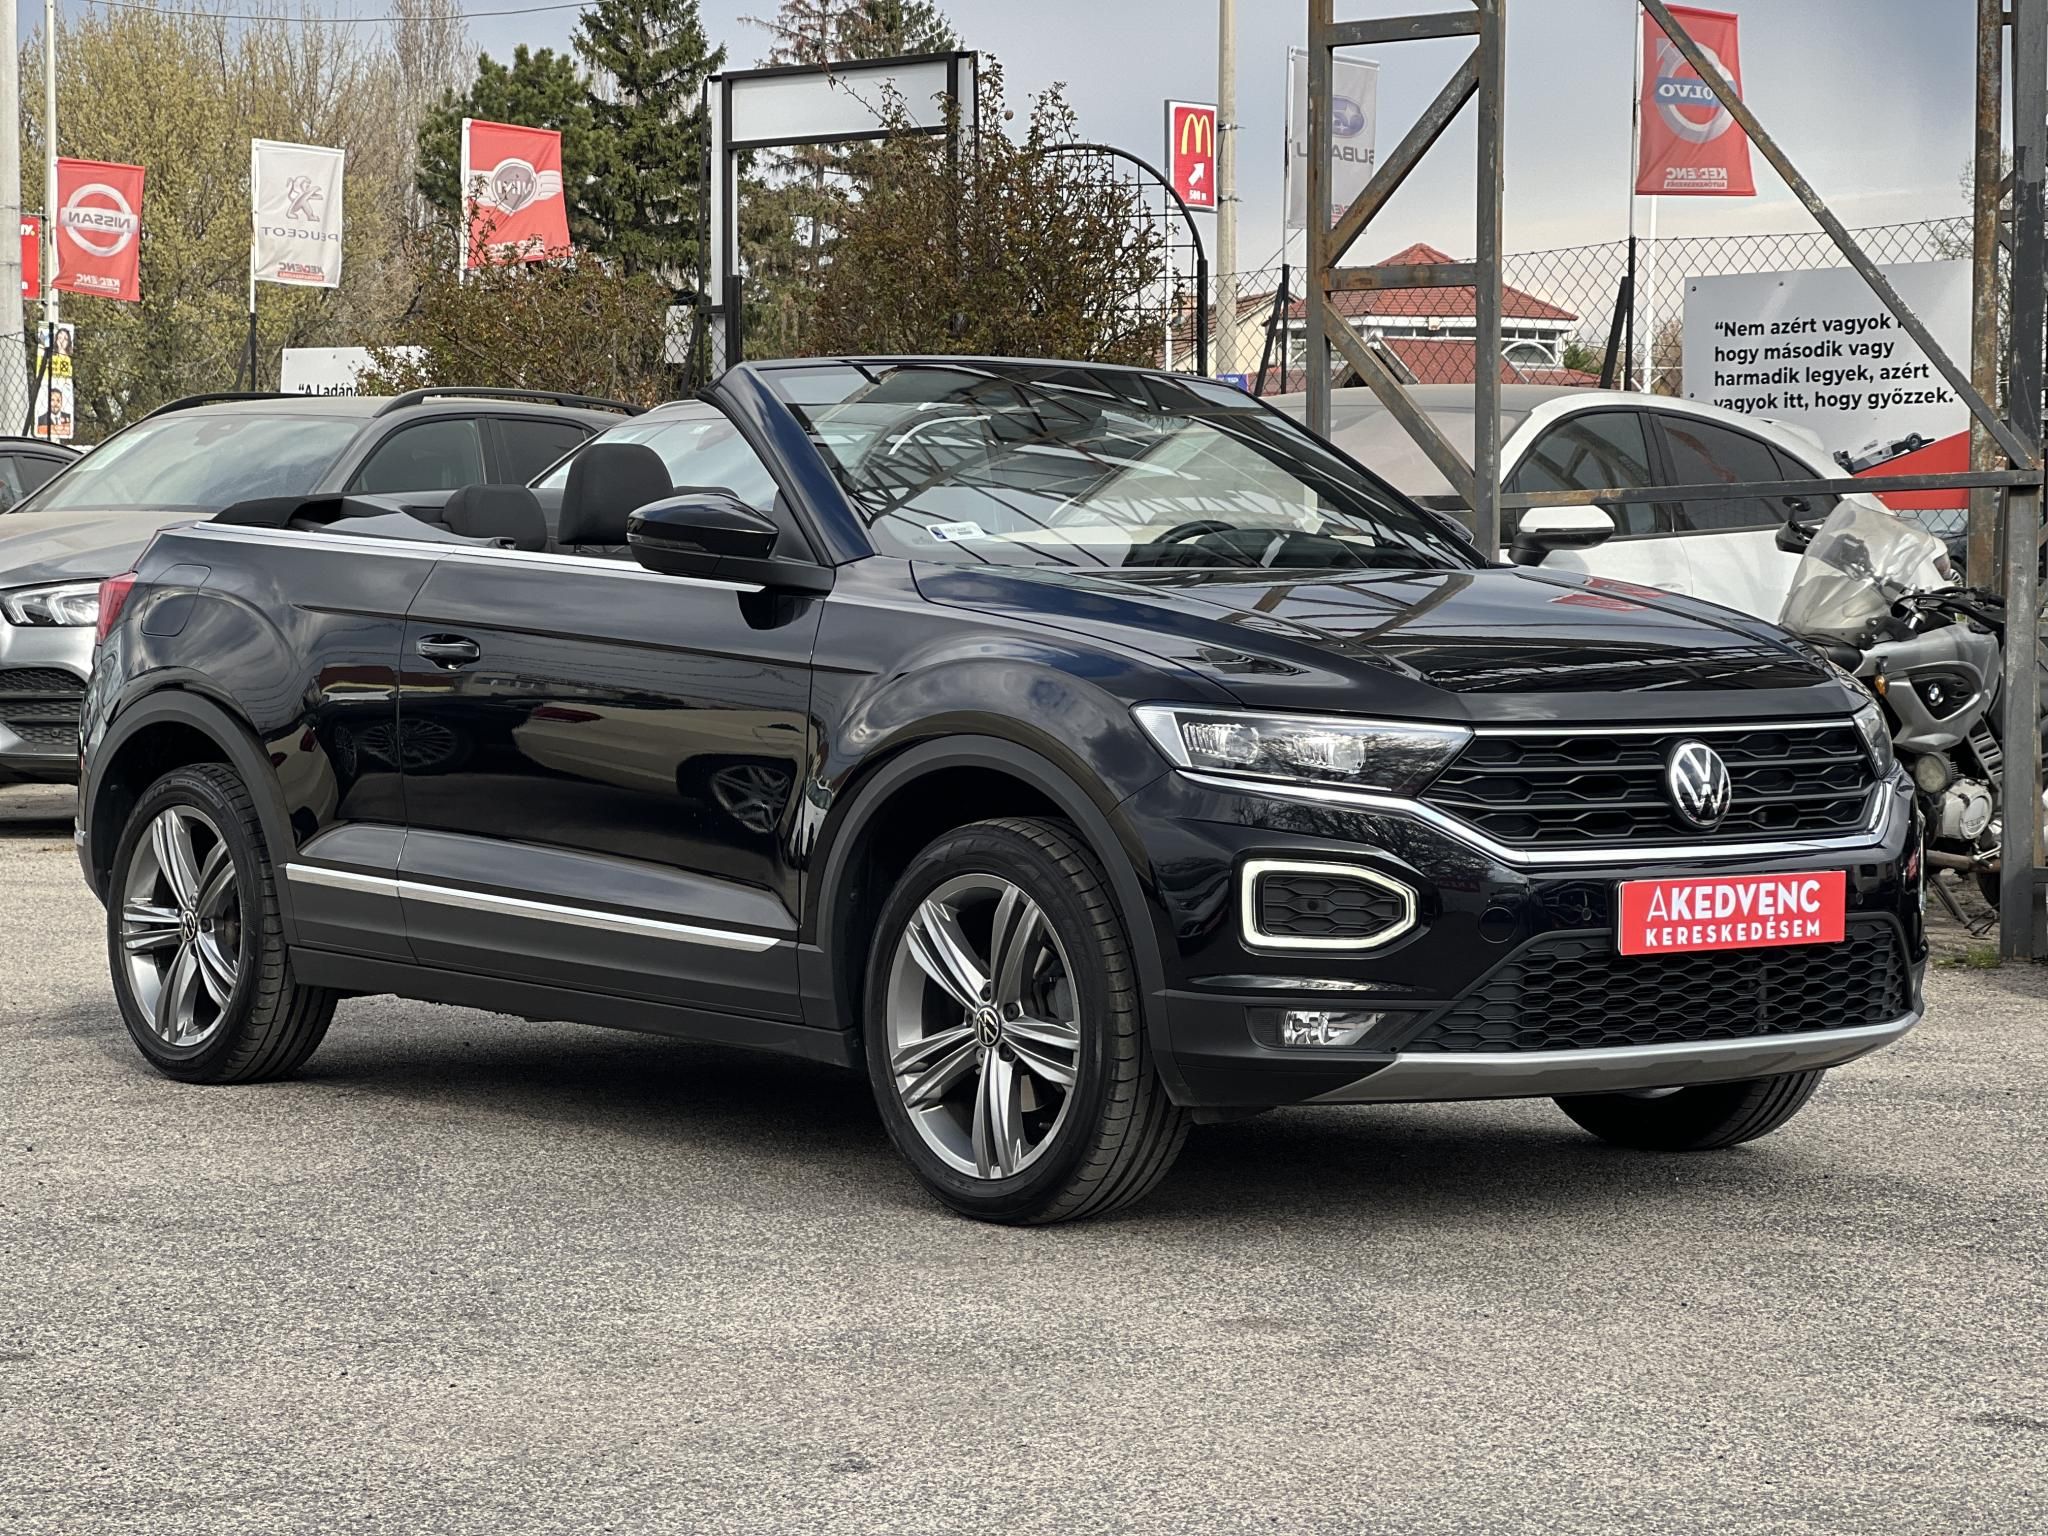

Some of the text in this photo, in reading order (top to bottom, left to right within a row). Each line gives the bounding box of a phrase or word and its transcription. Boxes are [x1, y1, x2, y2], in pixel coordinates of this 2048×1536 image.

[1714, 321, 1765, 337] “Nem
[1770, 317, 1817, 334] azért
[1822, 313, 1892, 335] vagyok
[1714, 340, 1895, 365] hogy második vagy
[1714, 362, 1930, 386] harmadik legyek, azért
[1784, 391, 1809, 411] itt,
[1815, 390, 1862, 411] hogy
[1646, 916, 1820, 948] KERESKEDÉSEM
